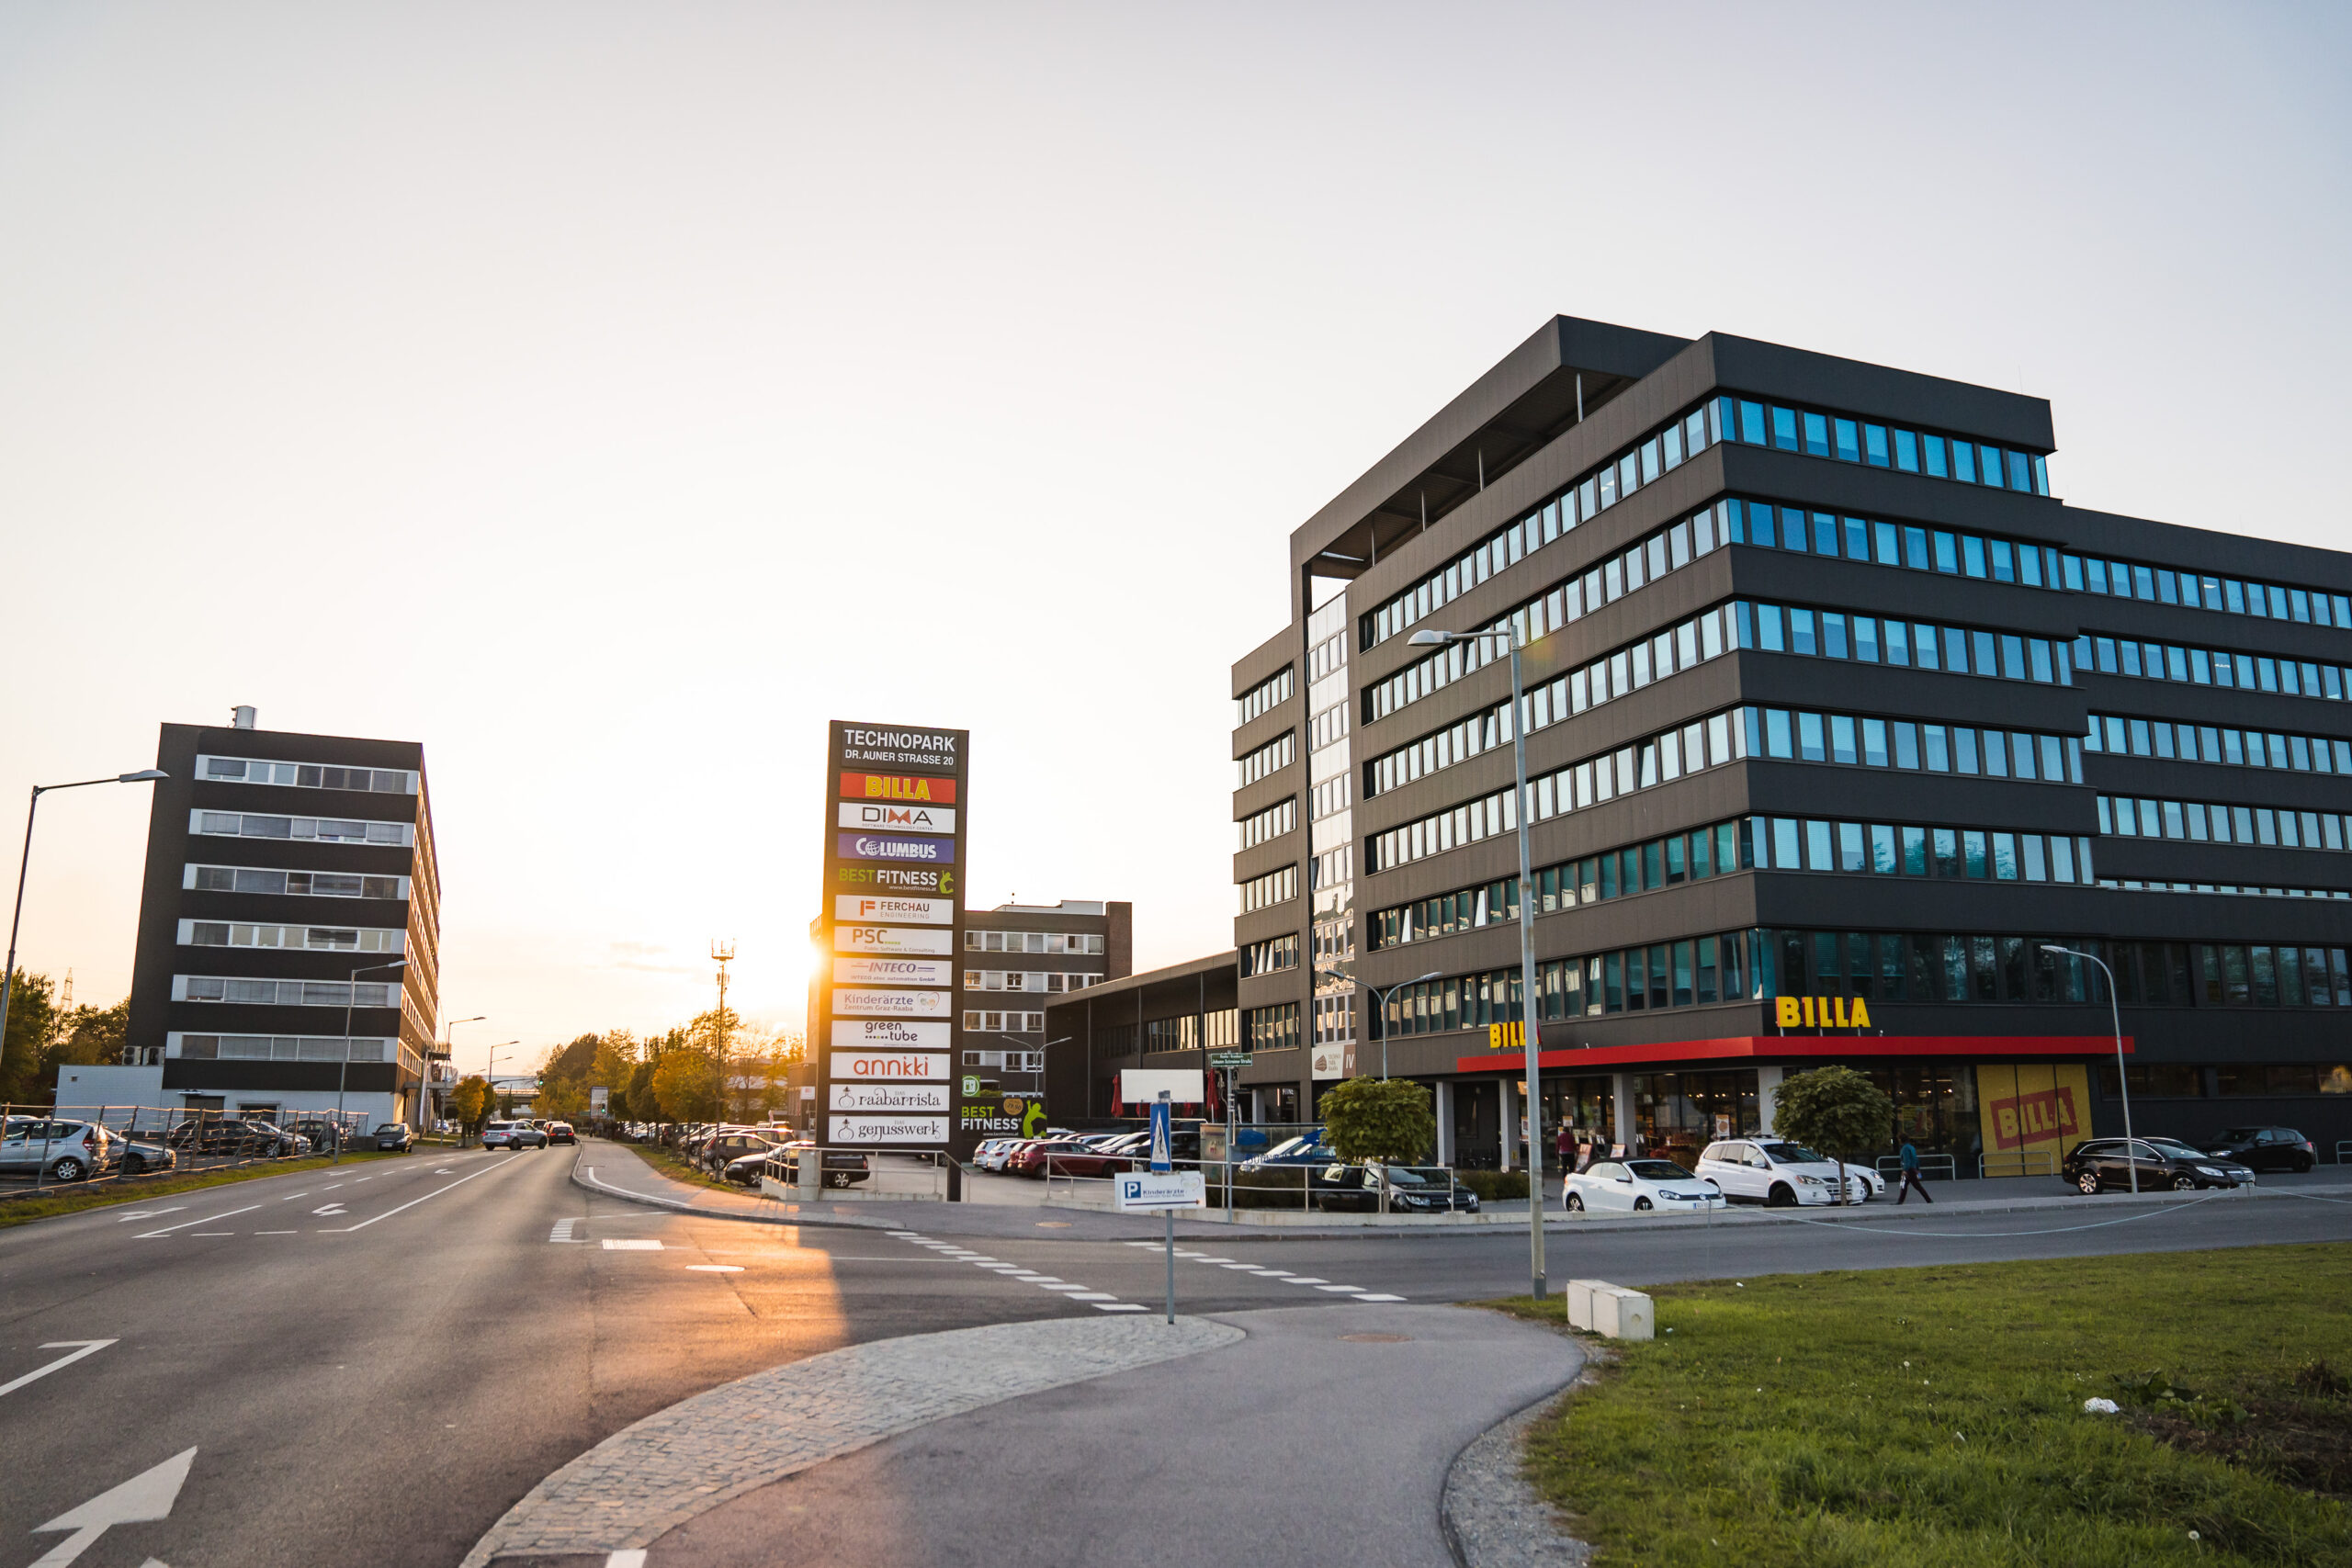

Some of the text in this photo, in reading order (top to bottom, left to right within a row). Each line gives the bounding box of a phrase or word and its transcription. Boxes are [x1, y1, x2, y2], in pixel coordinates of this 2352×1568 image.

[844, 729, 956, 752] TECHNOPARK
[845, 750, 954, 766] DR. AUNER STRASSE 20
[865, 775, 932, 801] BILLA
[862, 807, 933, 826] DIMA
[855, 837, 937, 859] COLUMBUS
[838, 867, 938, 886] BEST FITNESS
[880, 901, 930, 912] FERCHAU
[852, 928, 888, 944] PSC
[868, 962, 917, 974] INTECO
[844, 993, 914, 1006] Kinderärzte
[1775, 996, 1871, 1028] BILLA
[865, 1021, 902, 1033] green
[889, 1030, 918, 1042] tube
[1489, 1021, 1542, 1048] BILL
[853, 1055, 929, 1077] annikki
[859, 1087, 942, 1106] raabarrista
[961, 1105, 996, 1118] BEST
[1997, 1097, 2073, 1139] BILLA
[961, 1118, 1019, 1131] FITNESS
